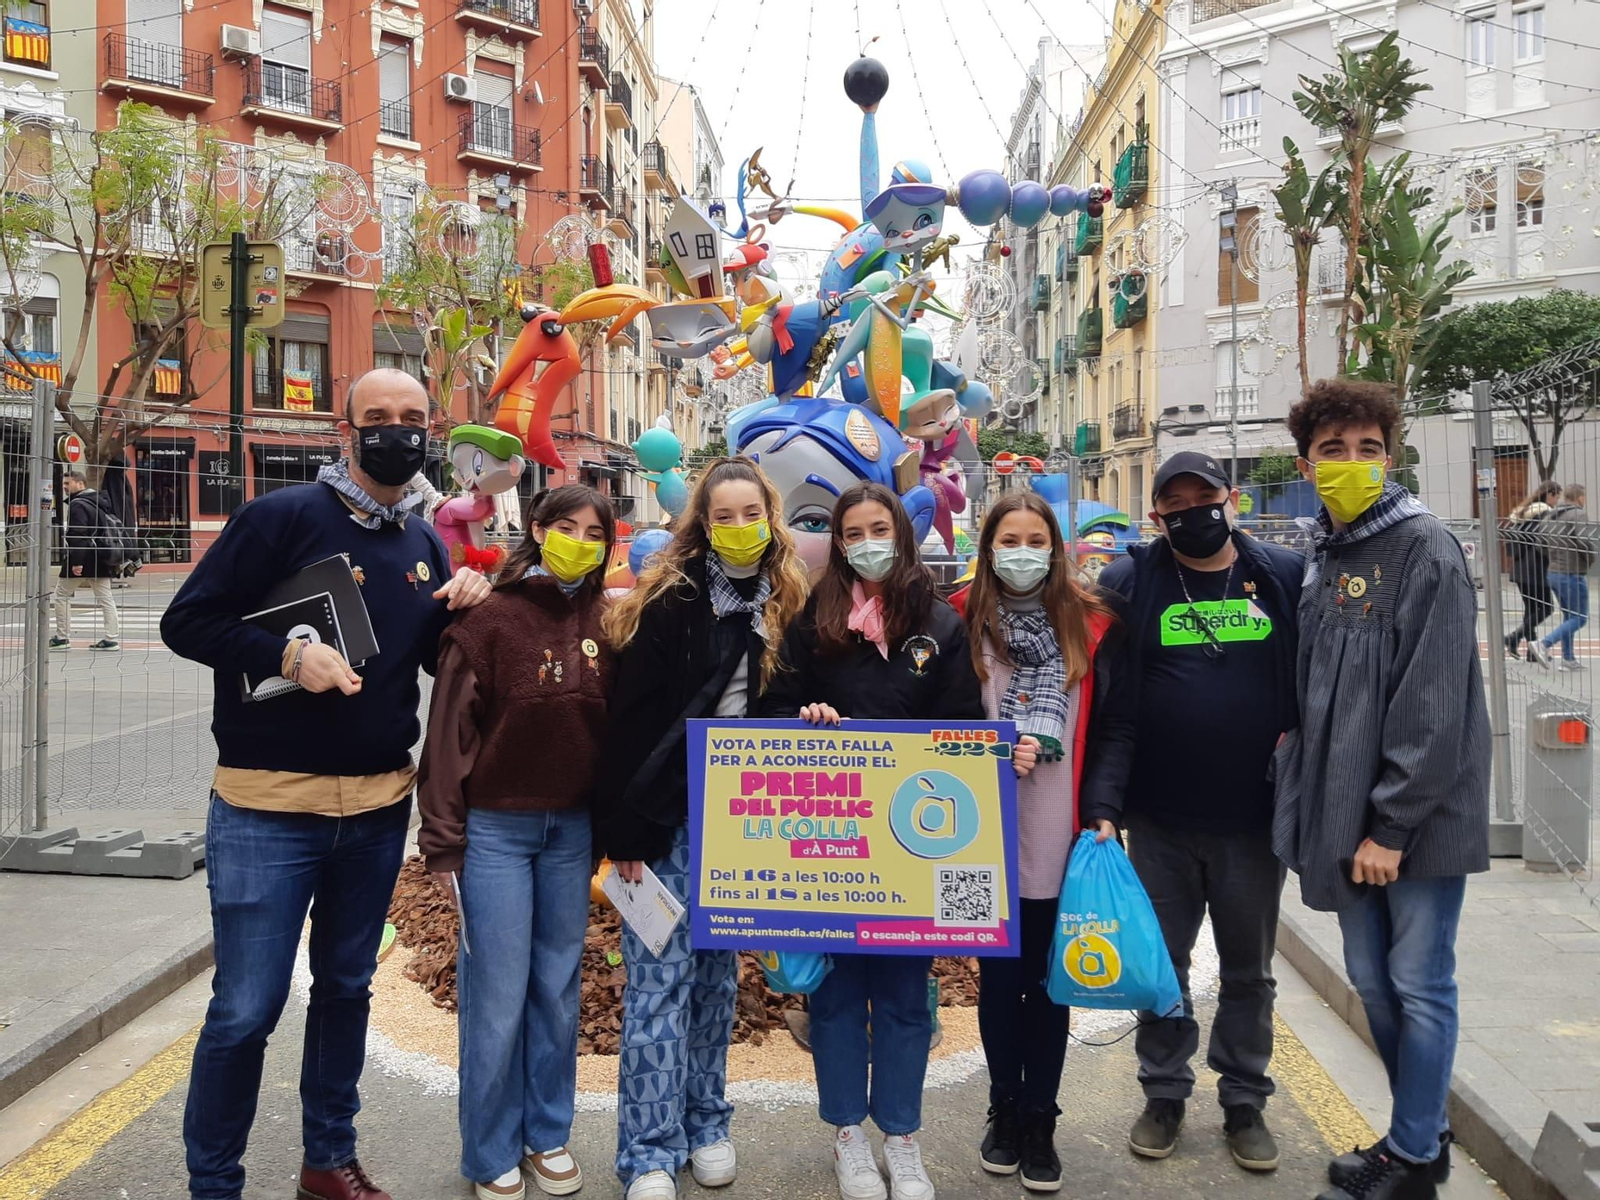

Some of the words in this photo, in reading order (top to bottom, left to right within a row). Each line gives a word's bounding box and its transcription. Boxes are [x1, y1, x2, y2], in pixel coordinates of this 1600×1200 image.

[932, 730, 998, 743] FALLES
[711, 739, 756, 751] VOTA
[760, 739, 792, 751] PER
[797, 739, 837, 751] ESTA
[842, 740, 894, 752] FALLA
[940, 742, 985, 757] 22
[710, 754, 741, 766] PER
[745, 754, 757, 766] A
[761, 755, 867, 768] ACONSEGUIR
[872, 757, 896, 768] EL:
[740, 771, 862, 797] PREMI
[729, 798, 776, 817] DEL
[779, 794, 874, 819] PÚBLIC
[744, 818, 774, 840] LA
[778, 817, 860, 841] COLLA
[826, 844, 859, 857] Punt
[710, 869, 736, 881] Del
[741, 869, 777, 881] 16
[782, 872, 791, 882] a
[796, 871, 818, 883] les
[823, 872, 866, 884] 10:00
[870, 872, 880, 884] h
[710, 886, 741, 900] fins
[745, 888, 759, 900] al
[764, 888, 798, 901] 18
[803, 891, 812, 901] a
[817, 889, 840, 902] les
[844, 890, 887, 903] 10:00
[892, 891, 907, 904] h.
[710, 914, 735, 924] Vota
[737, 916, 755, 924] en:
[1086, 911, 1099, 920] de
[710, 927, 856, 939] www.apuntmedia.es/falles
[861, 930, 870, 939] O
[872, 931, 922, 942] escaneja
[924, 932, 949, 942] este
[950, 932, 975, 942] codi
[977, 932, 998, 943] QR.
